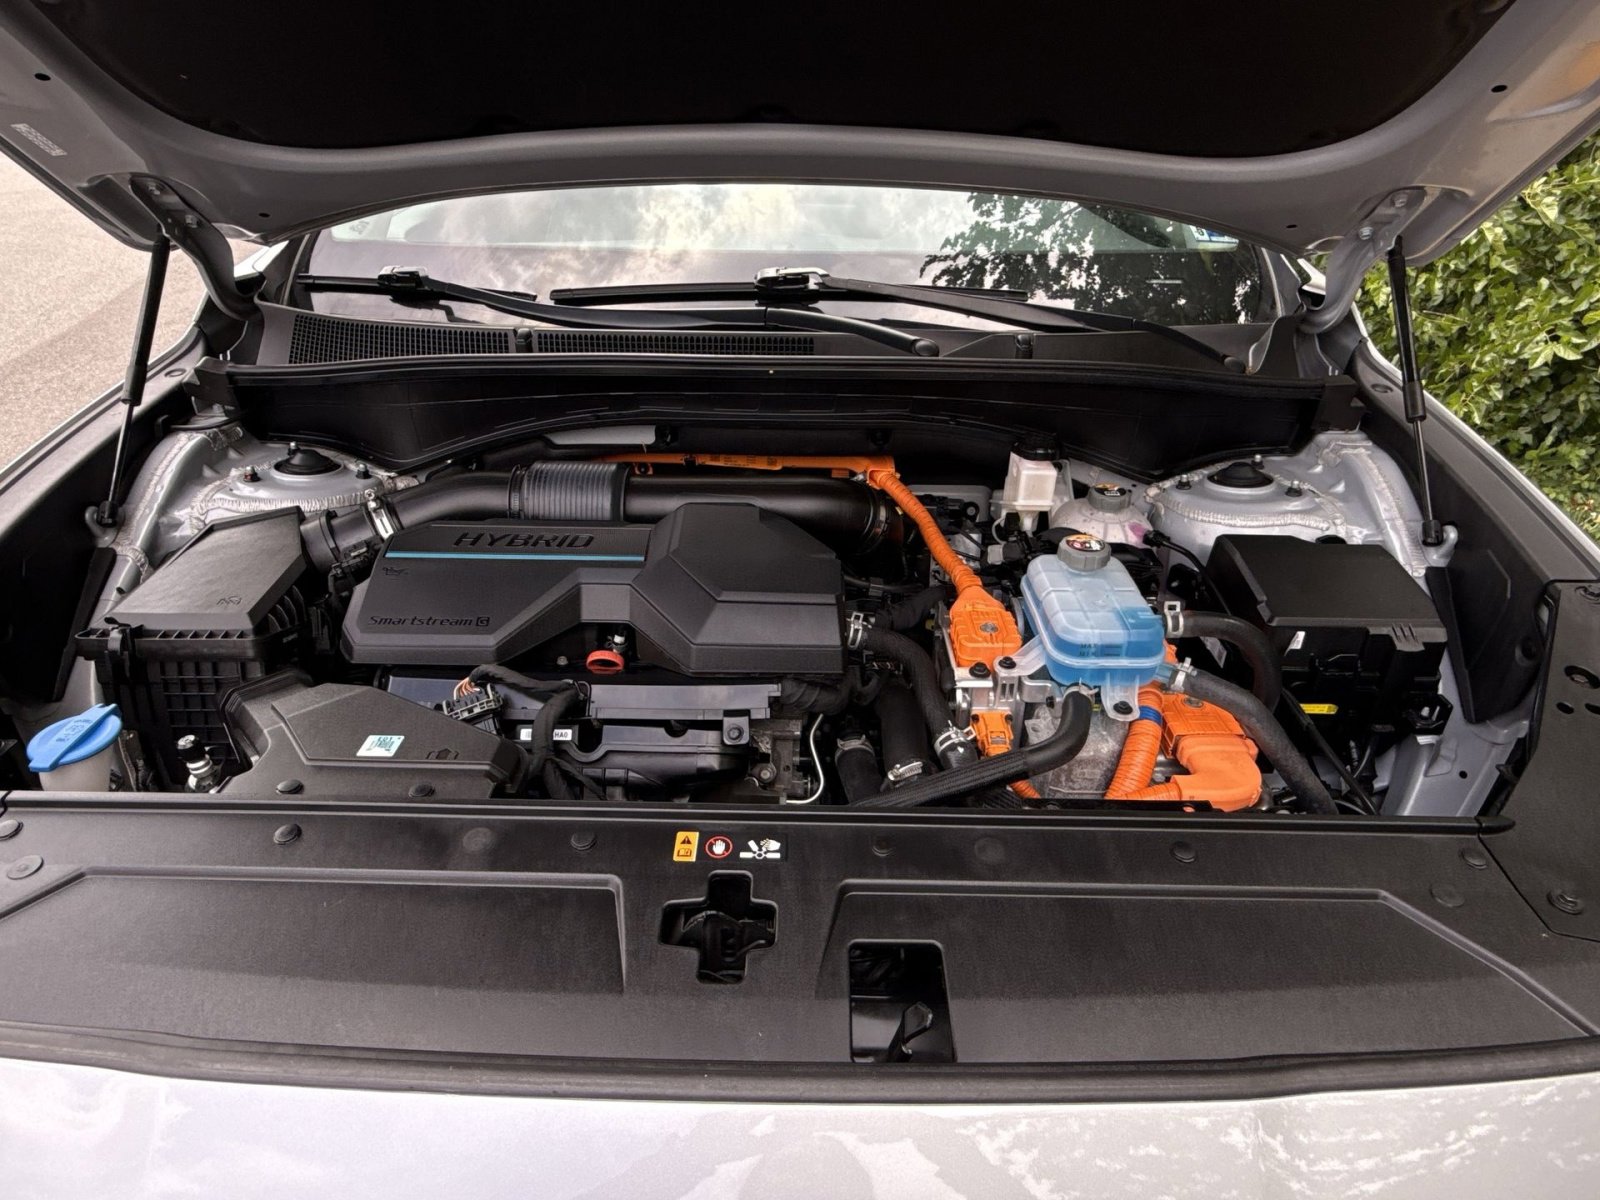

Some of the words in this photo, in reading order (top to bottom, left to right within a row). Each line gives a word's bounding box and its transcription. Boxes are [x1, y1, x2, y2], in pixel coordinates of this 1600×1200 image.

[453, 532, 595, 548] HYBRID
[368, 616, 473, 626] Smartstream
[475, 616, 490, 627] G
